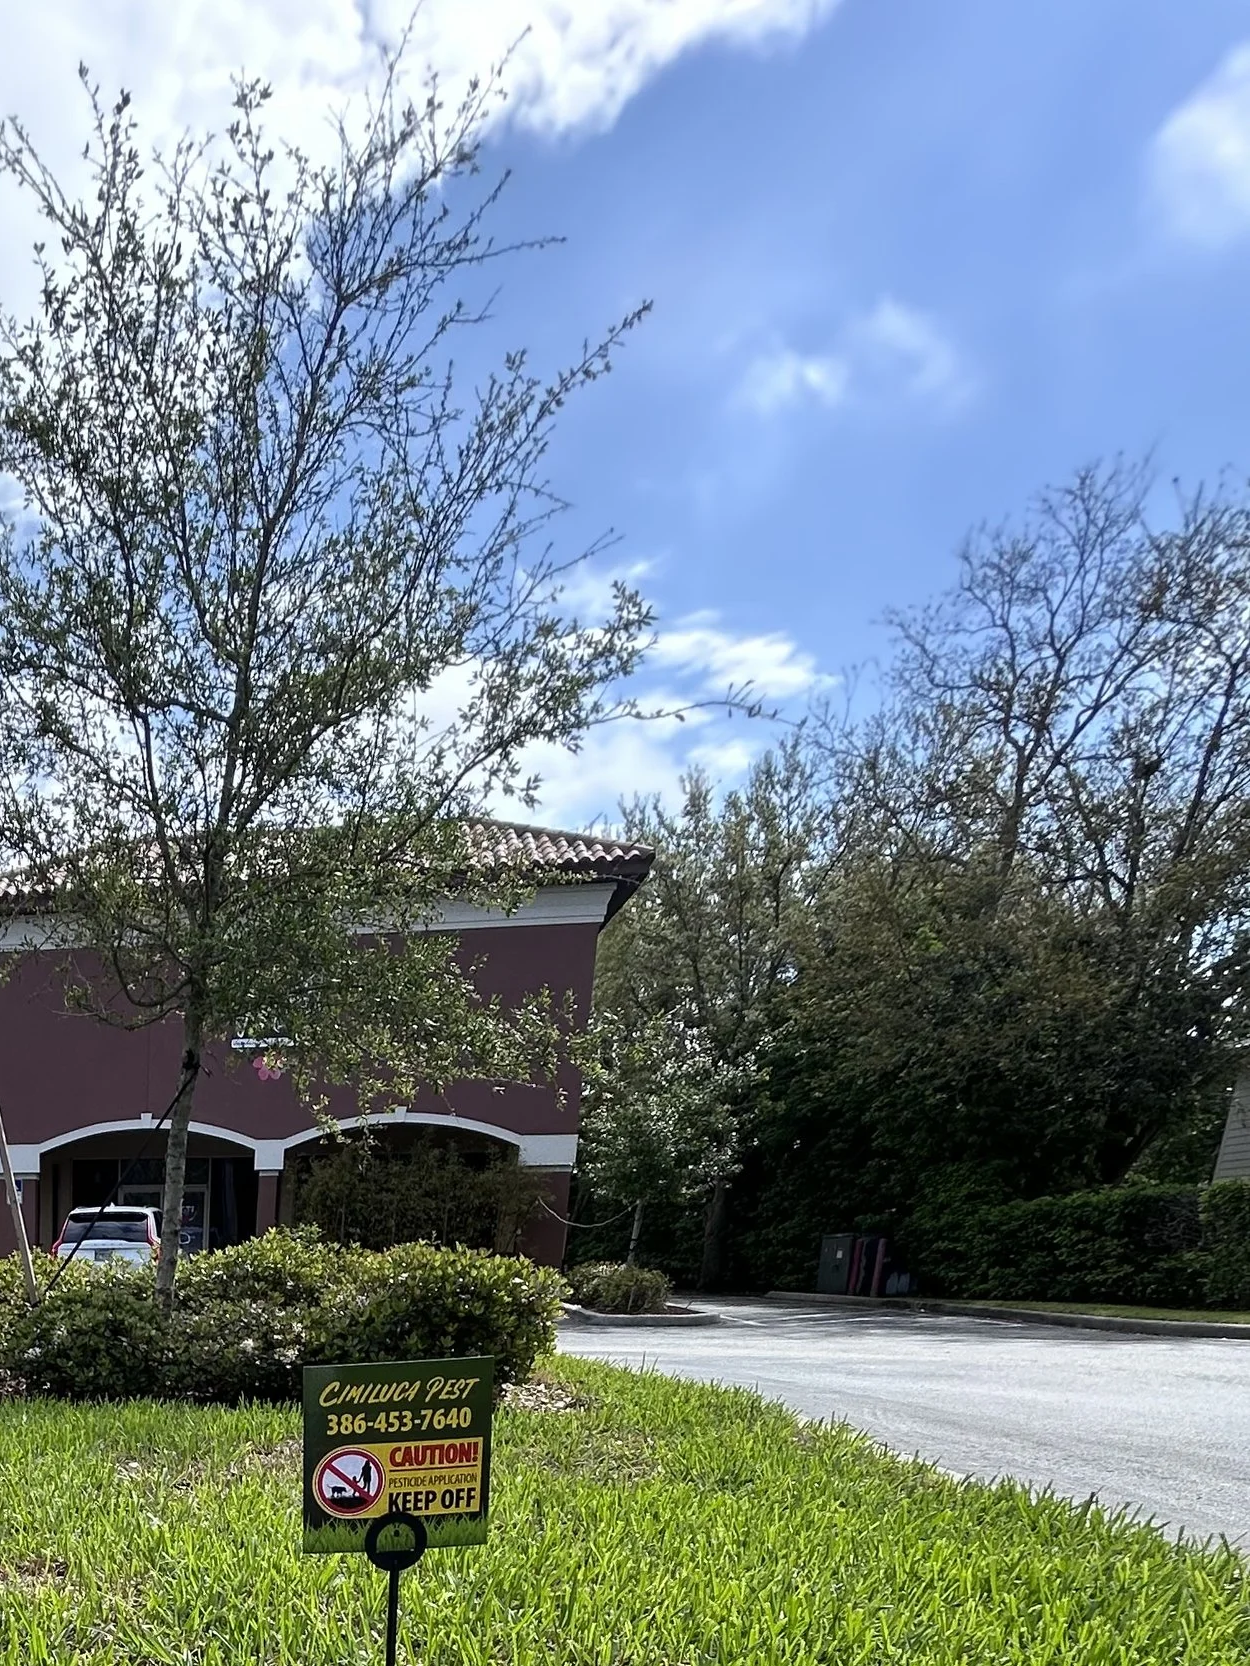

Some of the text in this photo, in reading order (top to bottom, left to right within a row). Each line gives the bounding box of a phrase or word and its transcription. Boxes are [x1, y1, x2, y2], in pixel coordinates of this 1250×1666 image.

[318, 1376, 480, 1407] CIMILUCA PEST
[326, 1407, 472, 1435] 386-453-7640
[389, 1442, 479, 1467] CAUTION!
[389, 1473, 477, 1488] PESTICIDE APPLICATION
[388, 1487, 476, 1514] KEEP OFF
